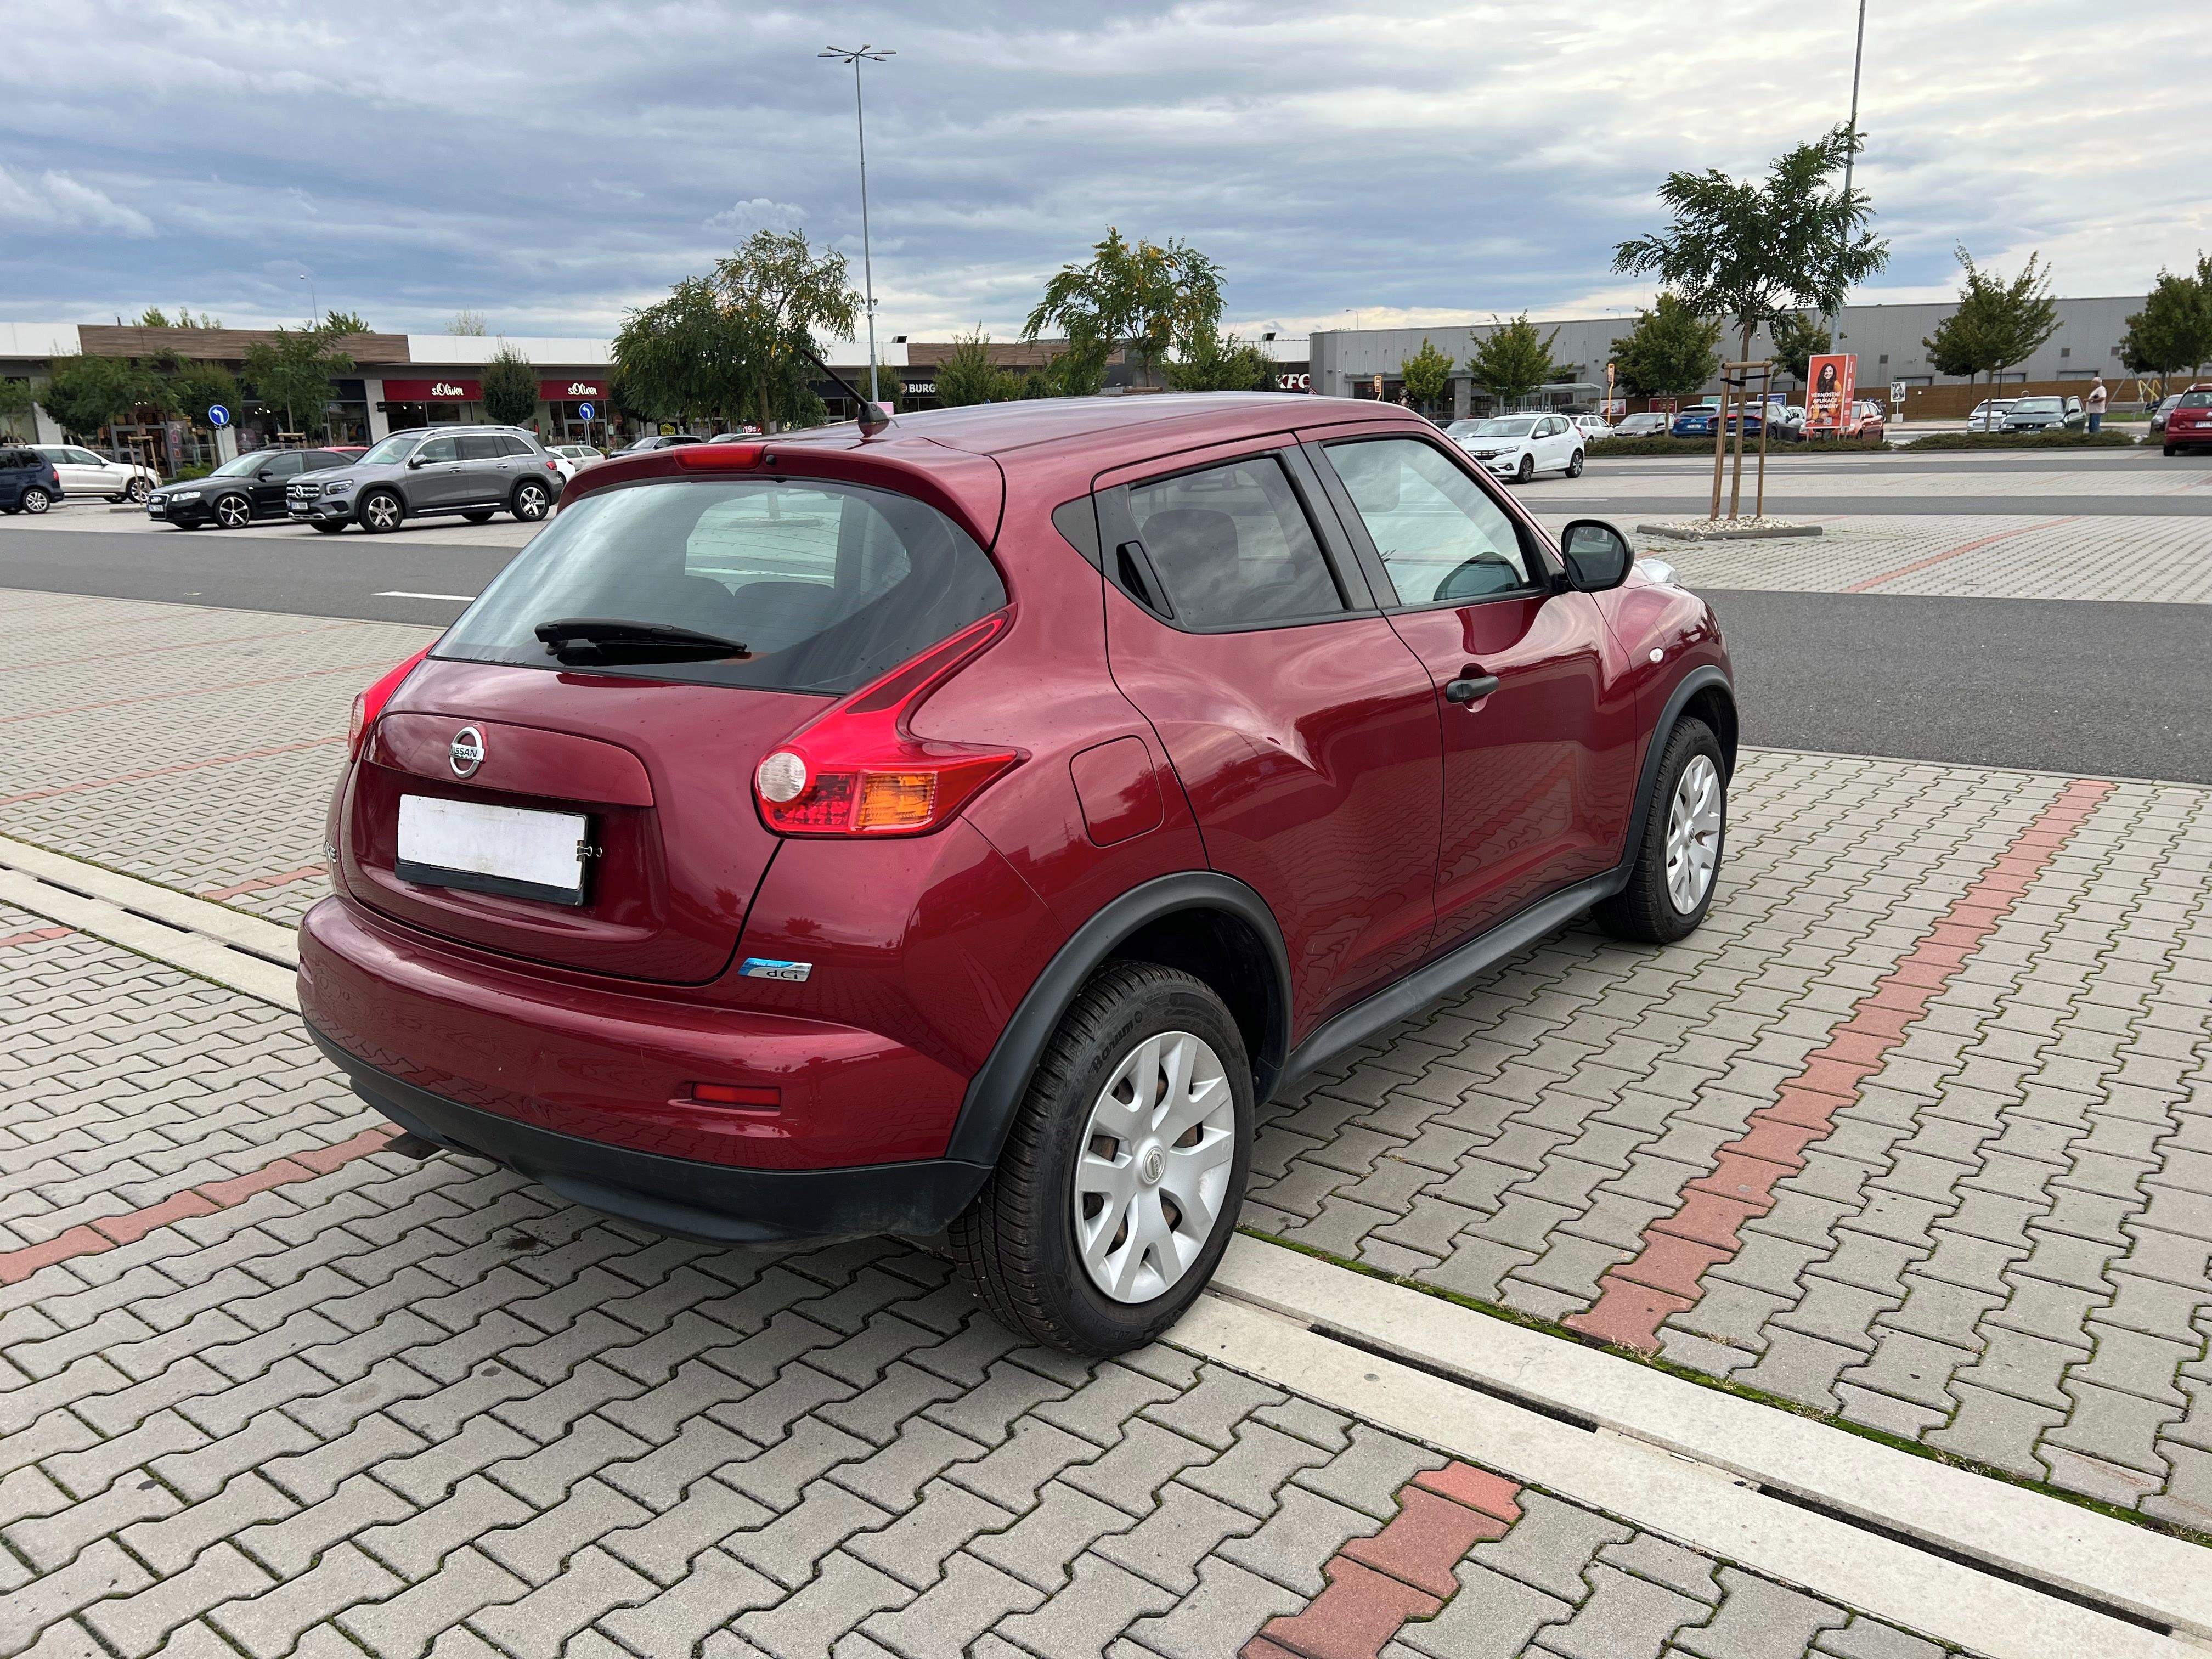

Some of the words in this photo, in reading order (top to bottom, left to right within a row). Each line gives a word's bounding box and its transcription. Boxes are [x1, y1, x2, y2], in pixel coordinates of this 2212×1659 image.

[1276, 374, 1310, 388] KFC
[432, 382, 464, 396] s.Oliver
[568, 382, 597, 395] s.Oliver
[909, 383, 936, 393] BURG
[766, 970, 798, 979] dCi
